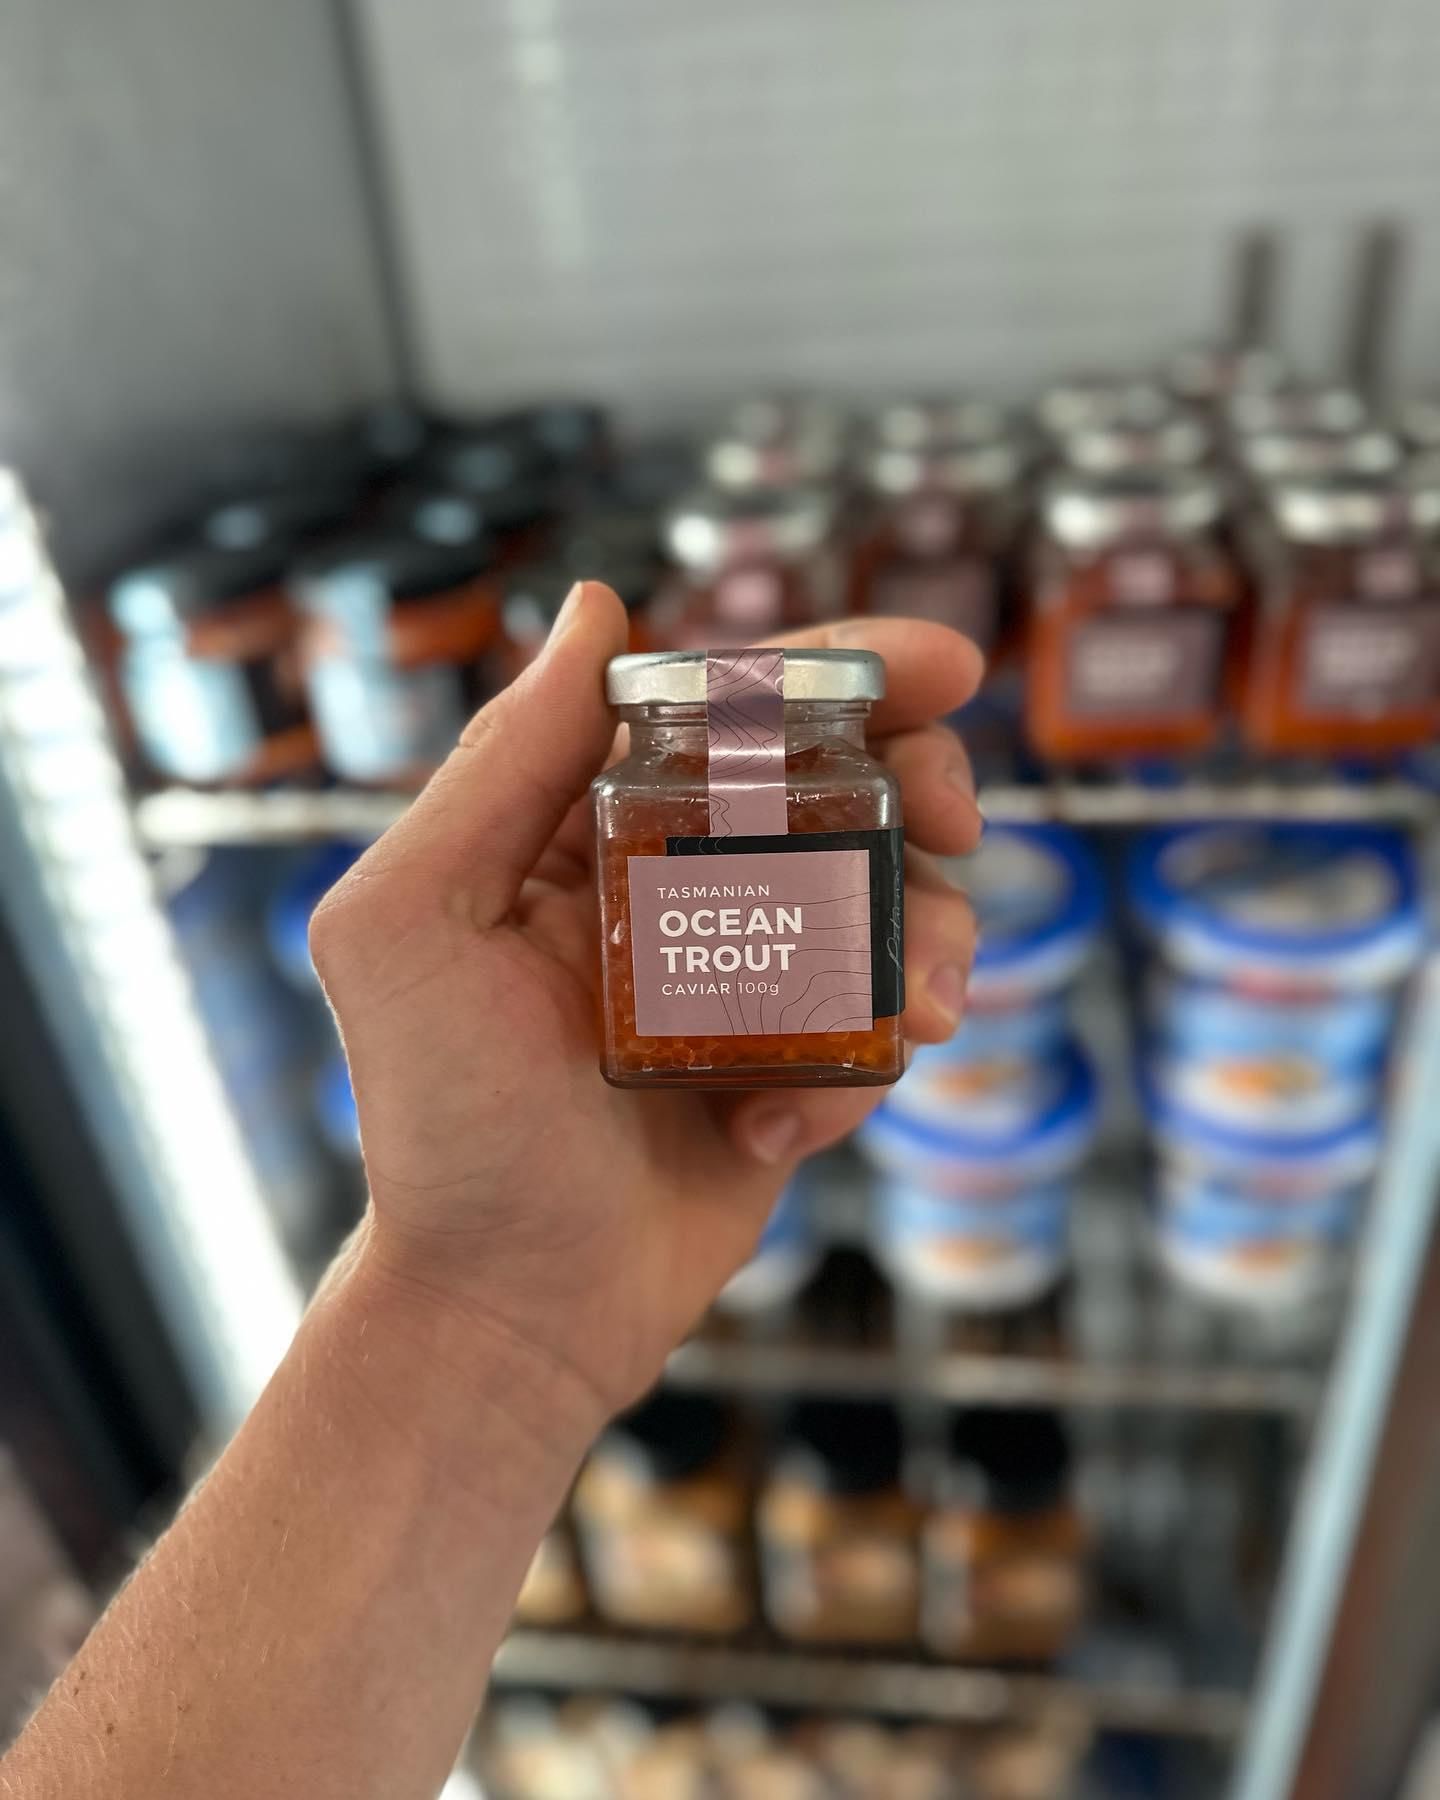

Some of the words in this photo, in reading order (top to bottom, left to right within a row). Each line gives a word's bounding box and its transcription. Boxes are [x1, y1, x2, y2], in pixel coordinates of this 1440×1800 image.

[657, 884, 770, 900] TASMANIAN
[658, 906, 803, 938] OCEAN
[659, 943, 797, 974] TROUT
[661, 982, 731, 996] CAVIAR
[737, 981, 779, 996] 100g
